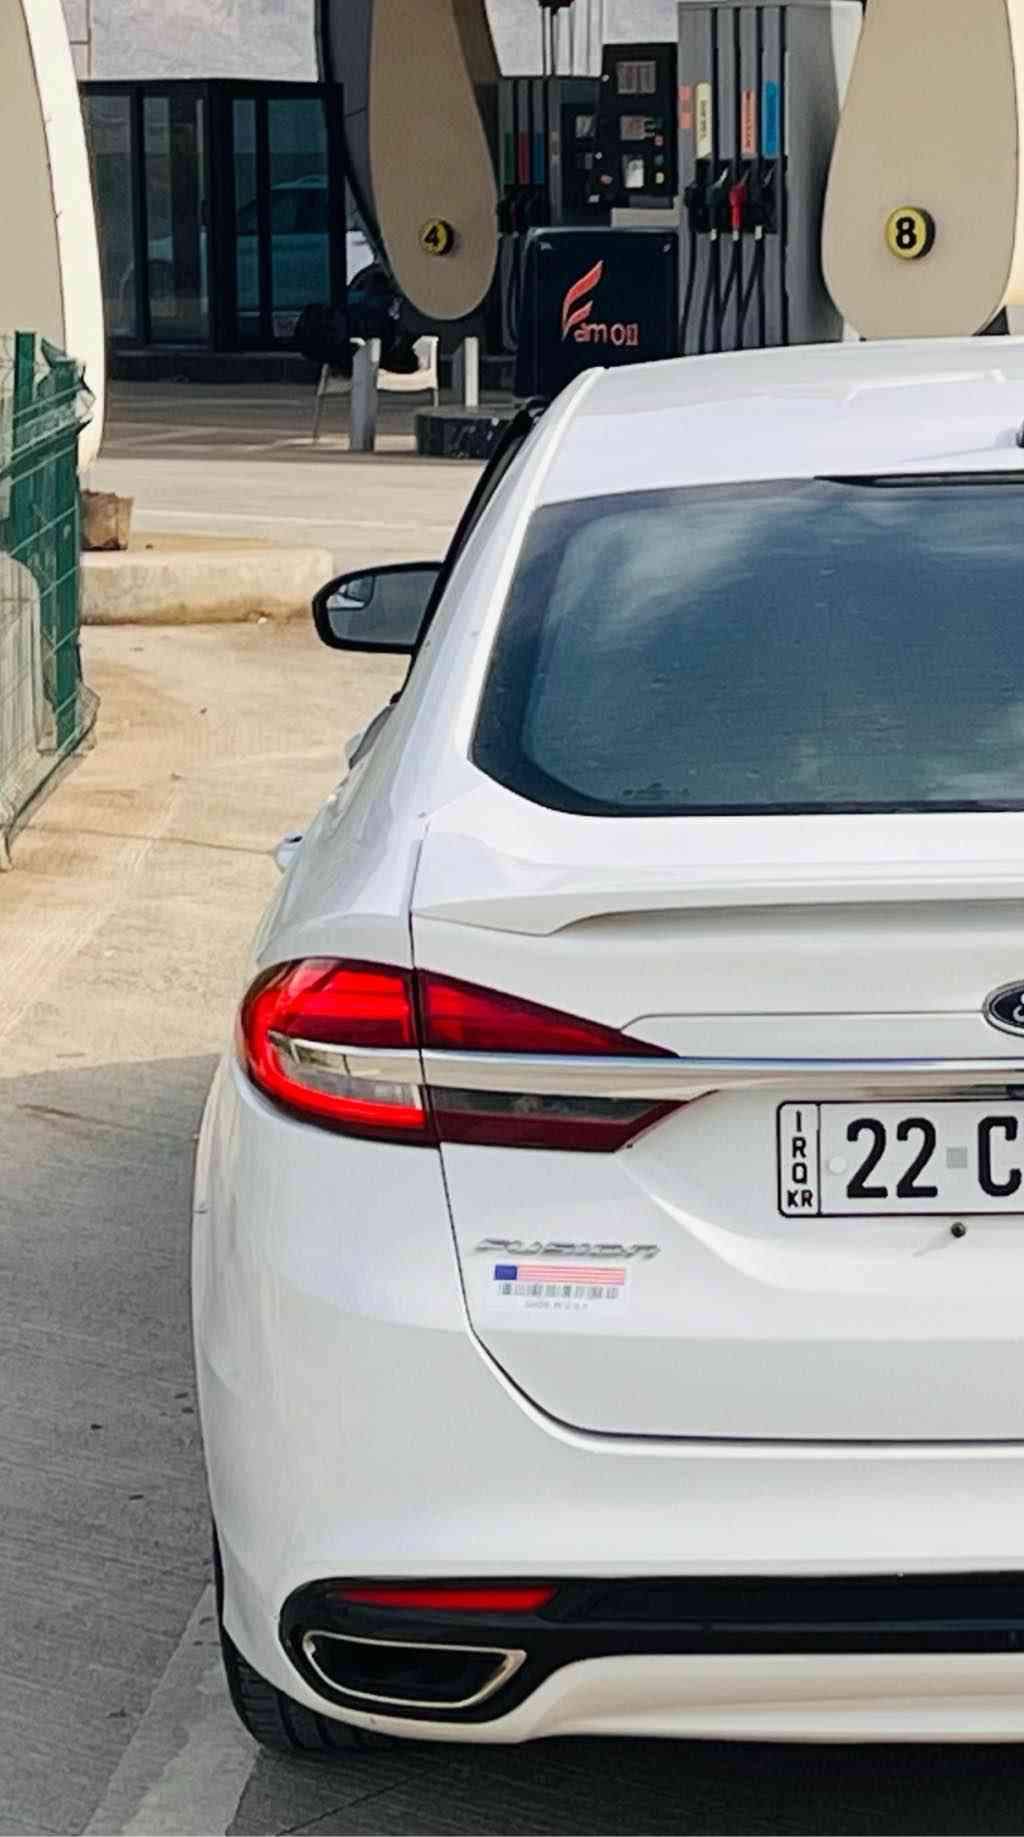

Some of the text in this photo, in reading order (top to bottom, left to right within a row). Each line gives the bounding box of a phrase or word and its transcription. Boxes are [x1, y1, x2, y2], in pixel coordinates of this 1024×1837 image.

[424, 225, 439, 247] 4
[896, 217, 917, 250] 8
[846, 1117, 938, 1198] 22
[977, 1115, 1022, 1197] C
[787, 1190, 813, 1208] KR
